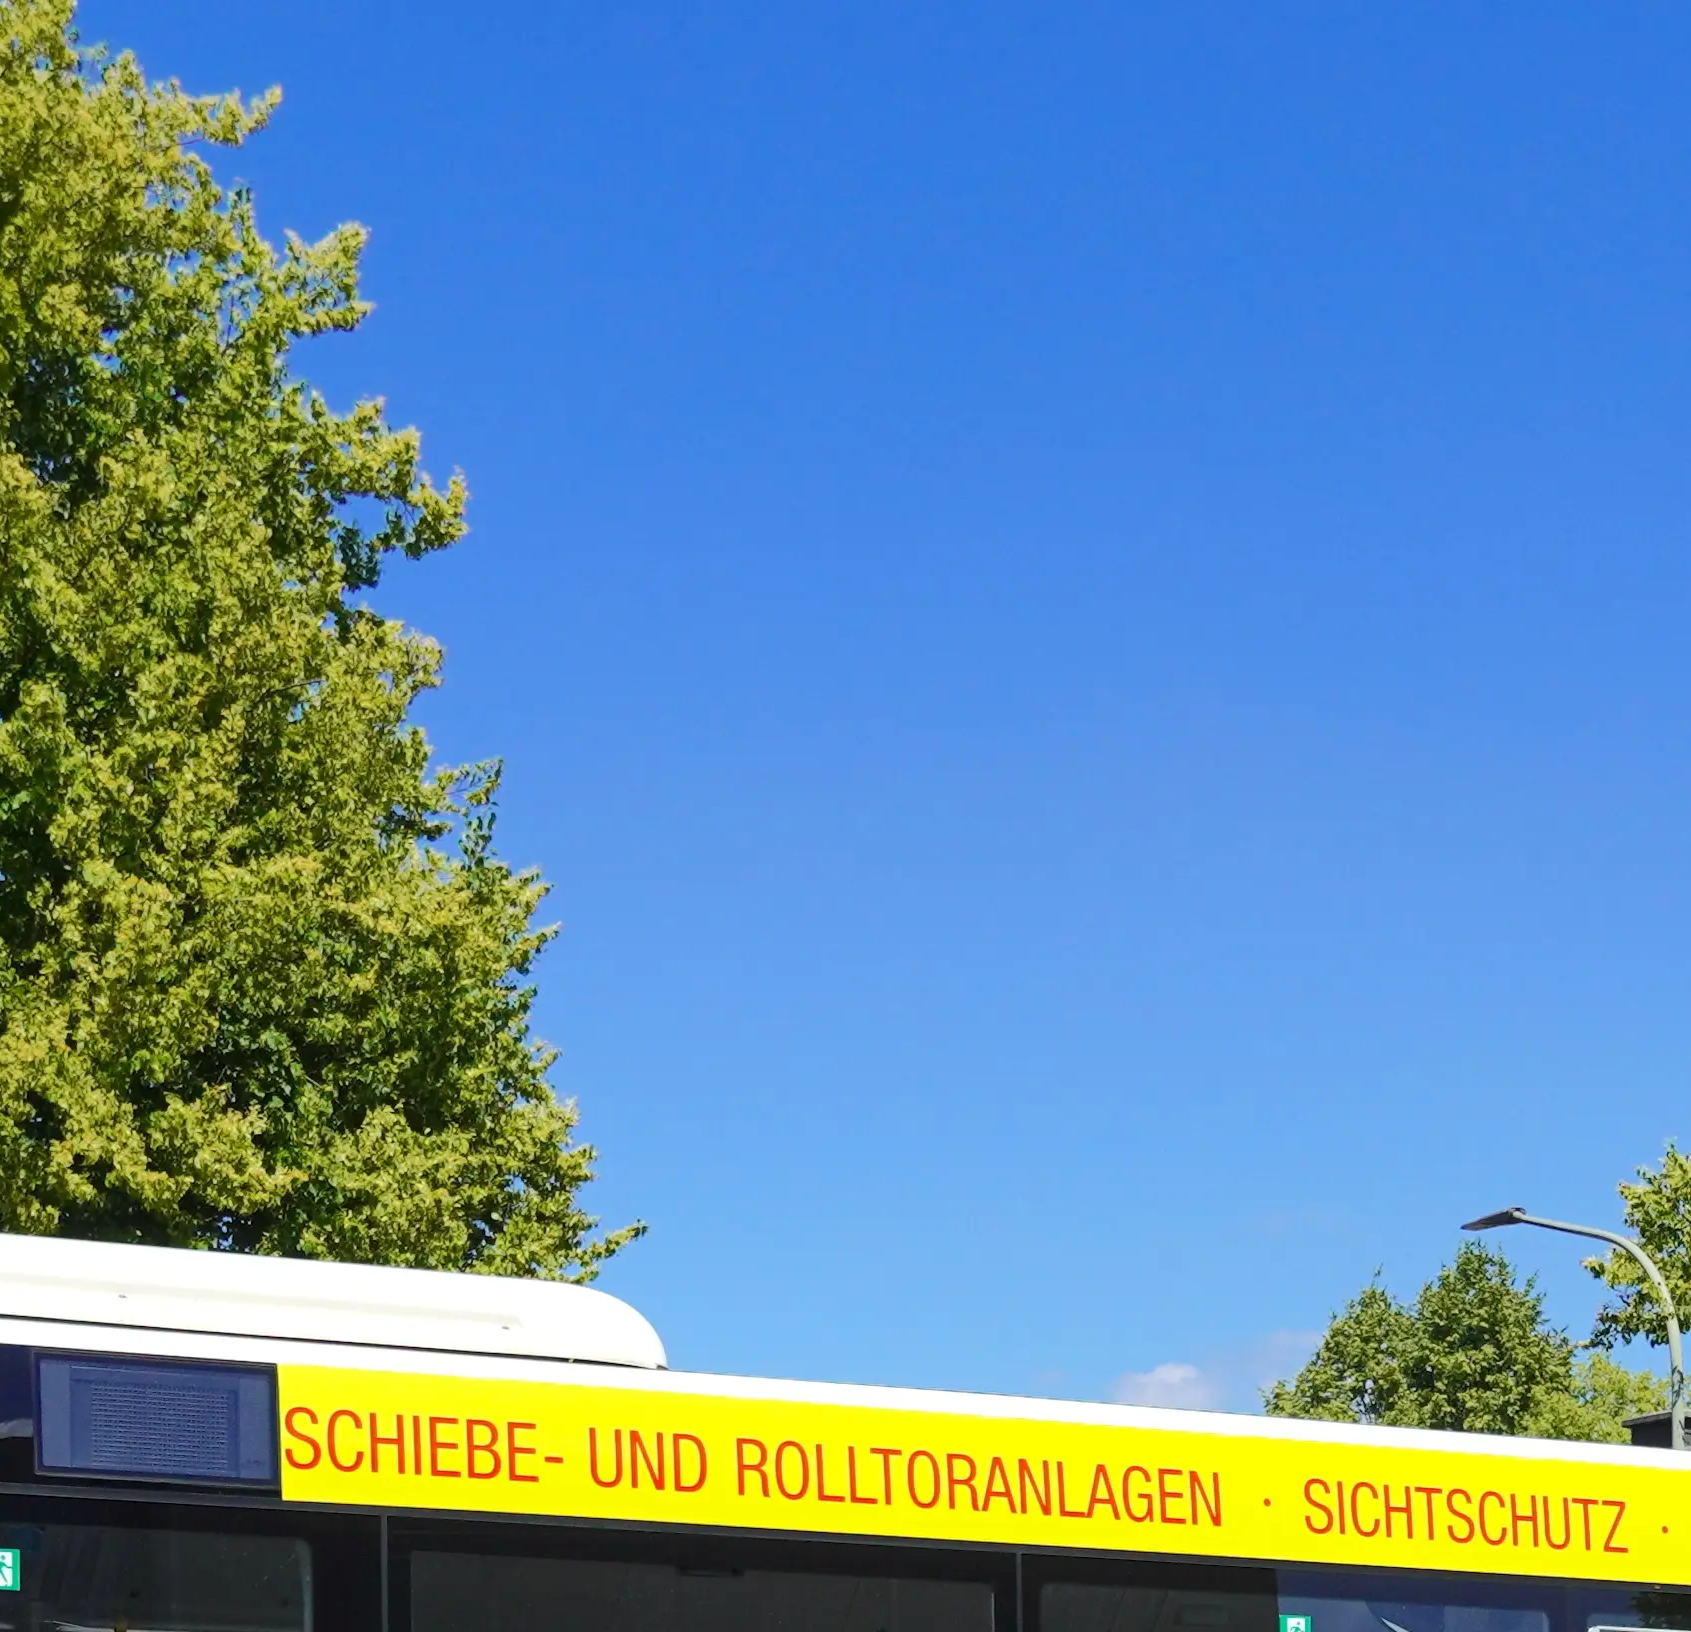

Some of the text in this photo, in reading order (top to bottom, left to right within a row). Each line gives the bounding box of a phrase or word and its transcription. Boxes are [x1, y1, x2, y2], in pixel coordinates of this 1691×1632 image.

[284, 1406, 564, 1483] SCHIEBE-
[589, 1427, 707, 1493] UND
[736, 1437, 1222, 1527] ROLLTORANLAGEN
[1303, 1478, 1629, 1554] SICHTSCHUTZ
